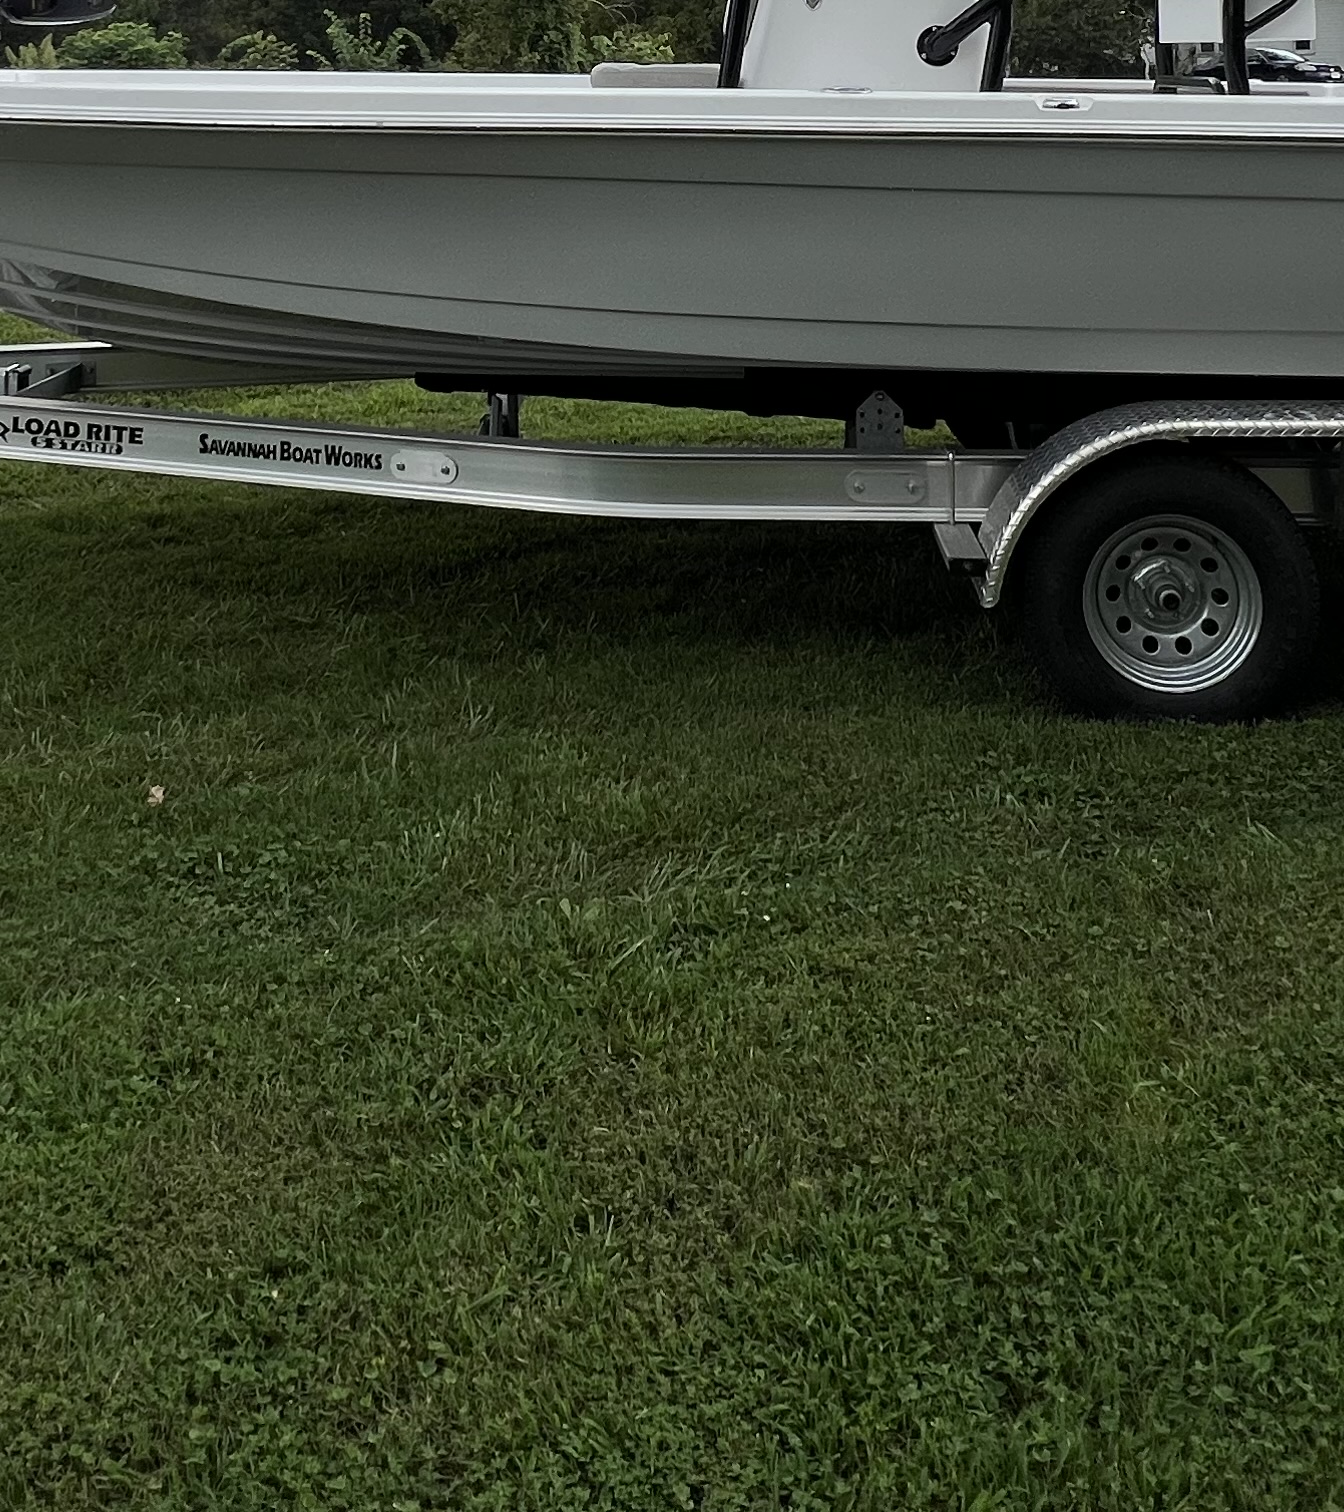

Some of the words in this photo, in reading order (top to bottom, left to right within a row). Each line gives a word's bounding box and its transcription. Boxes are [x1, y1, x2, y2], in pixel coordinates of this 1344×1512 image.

[11, 416, 81, 438] LOAD
[87, 423, 144, 445] RITE
[199, 433, 277, 461] SAVANNAH
[279, 440, 322, 464] BOAT
[324, 444, 383, 470] WORKS
